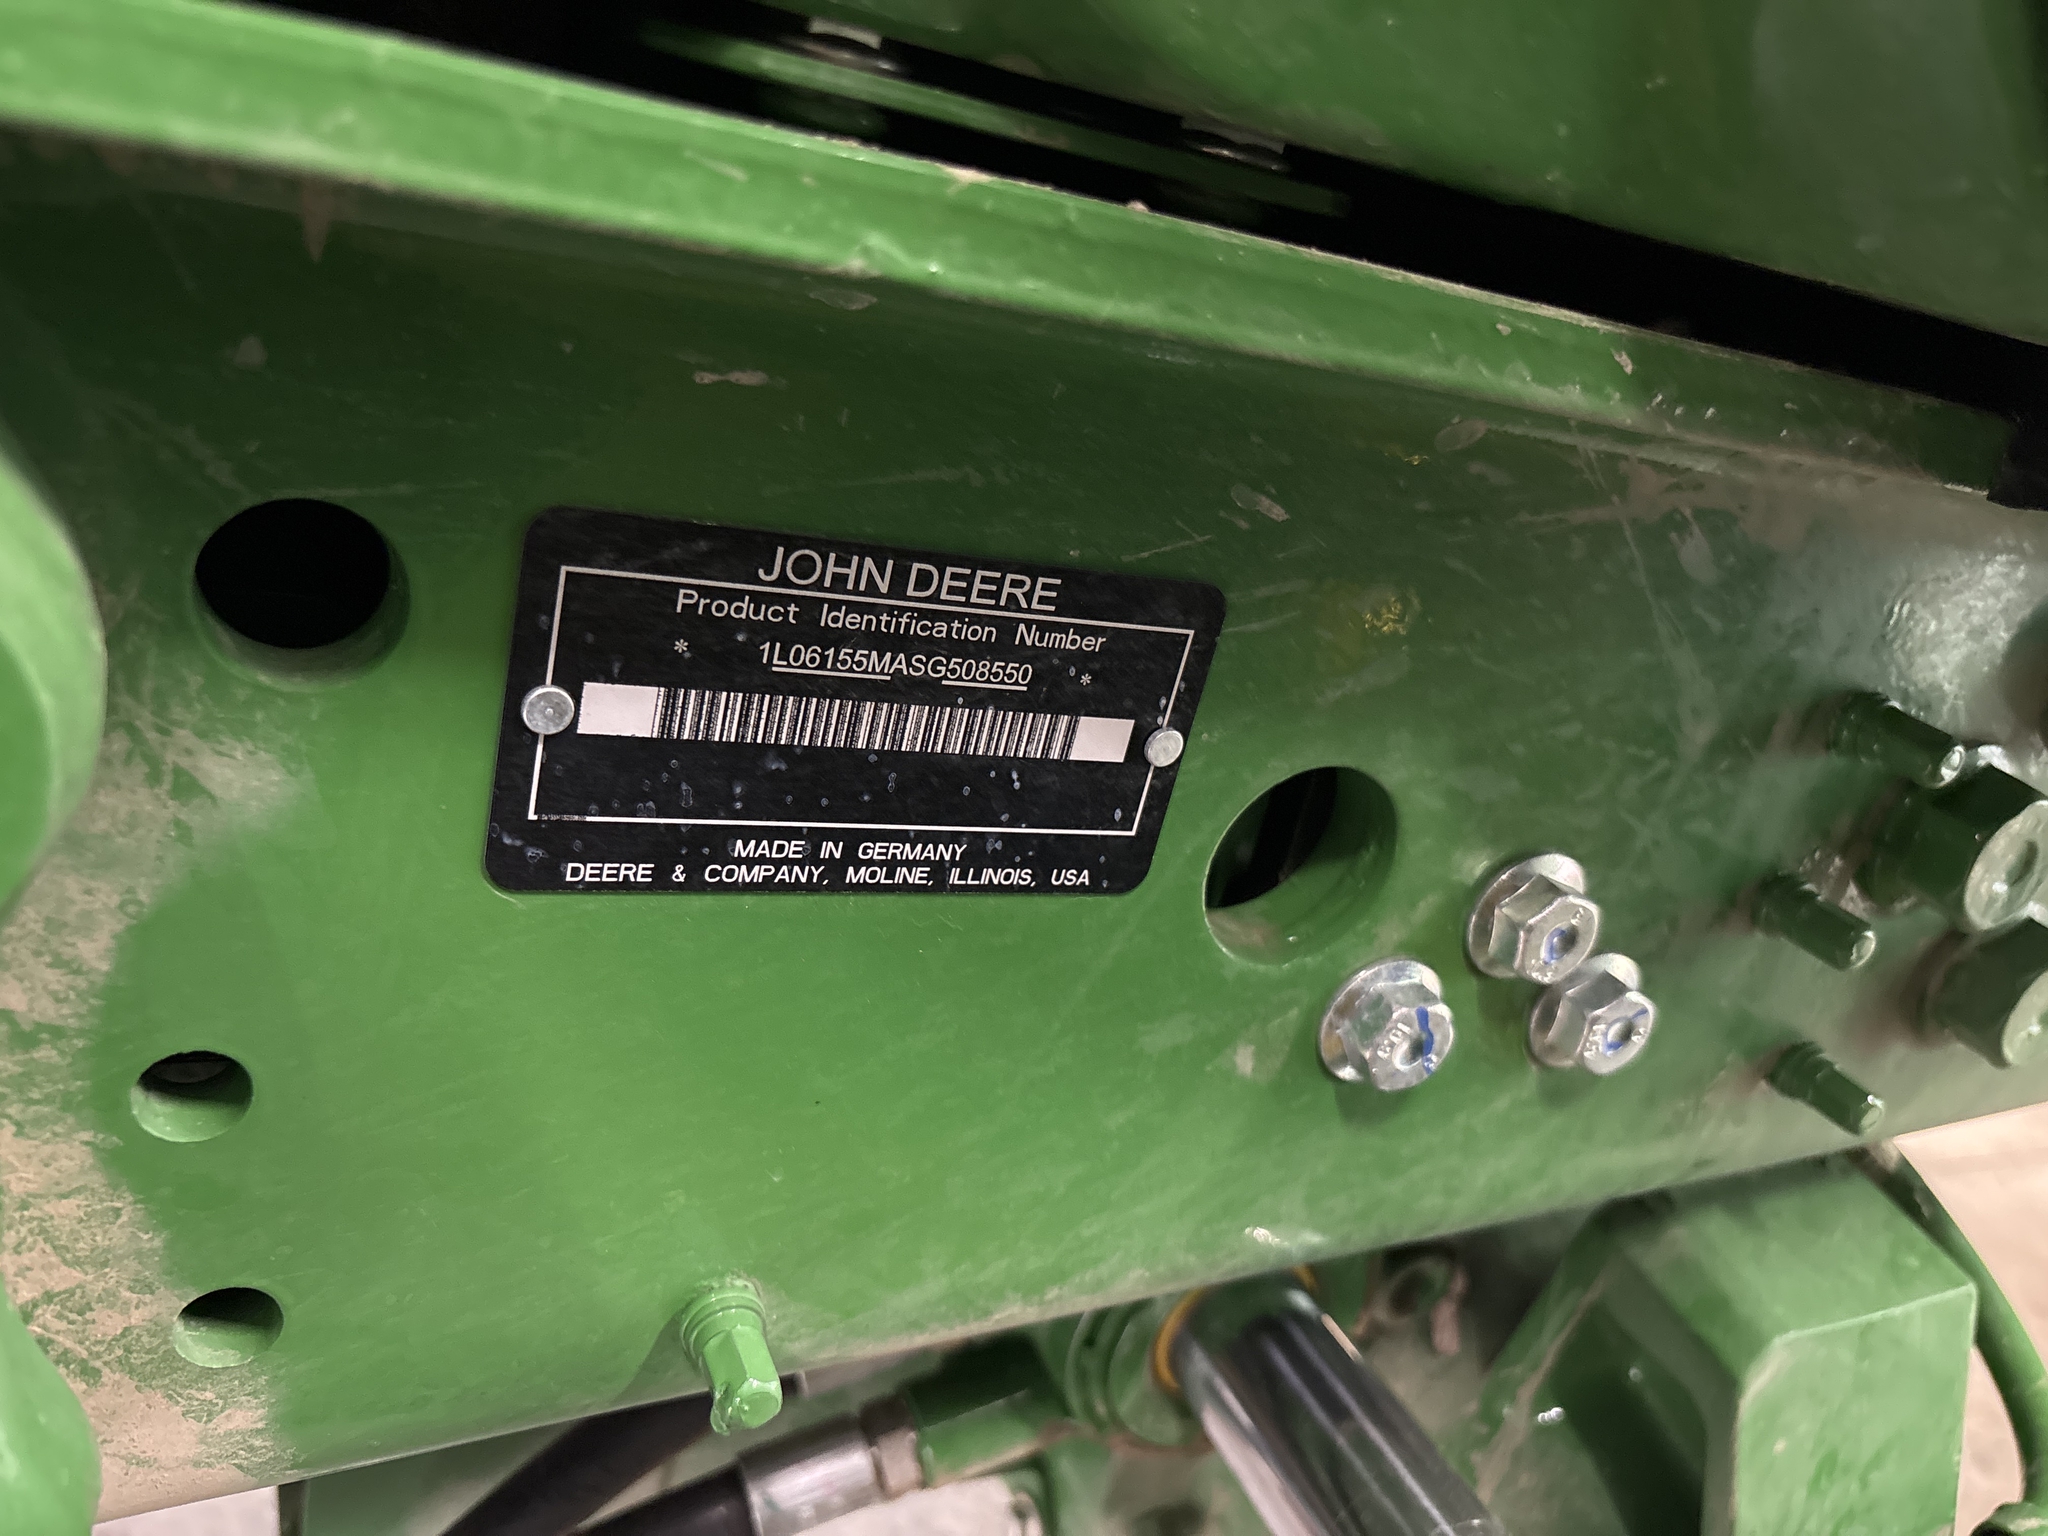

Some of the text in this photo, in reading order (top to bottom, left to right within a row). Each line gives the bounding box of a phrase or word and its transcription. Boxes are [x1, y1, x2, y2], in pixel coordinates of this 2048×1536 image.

[758, 546, 1062, 612] JOHN DEERE
[676, 588, 1107, 653] Product Identification Number
[759, 641, 1033, 687] 1L06155MASG508550
[733, 838, 968, 862] MADE IN GERMANY
[565, 862, 1090, 888] DEERE & COMPANY, MOLINE, ILLINOIS, USA
